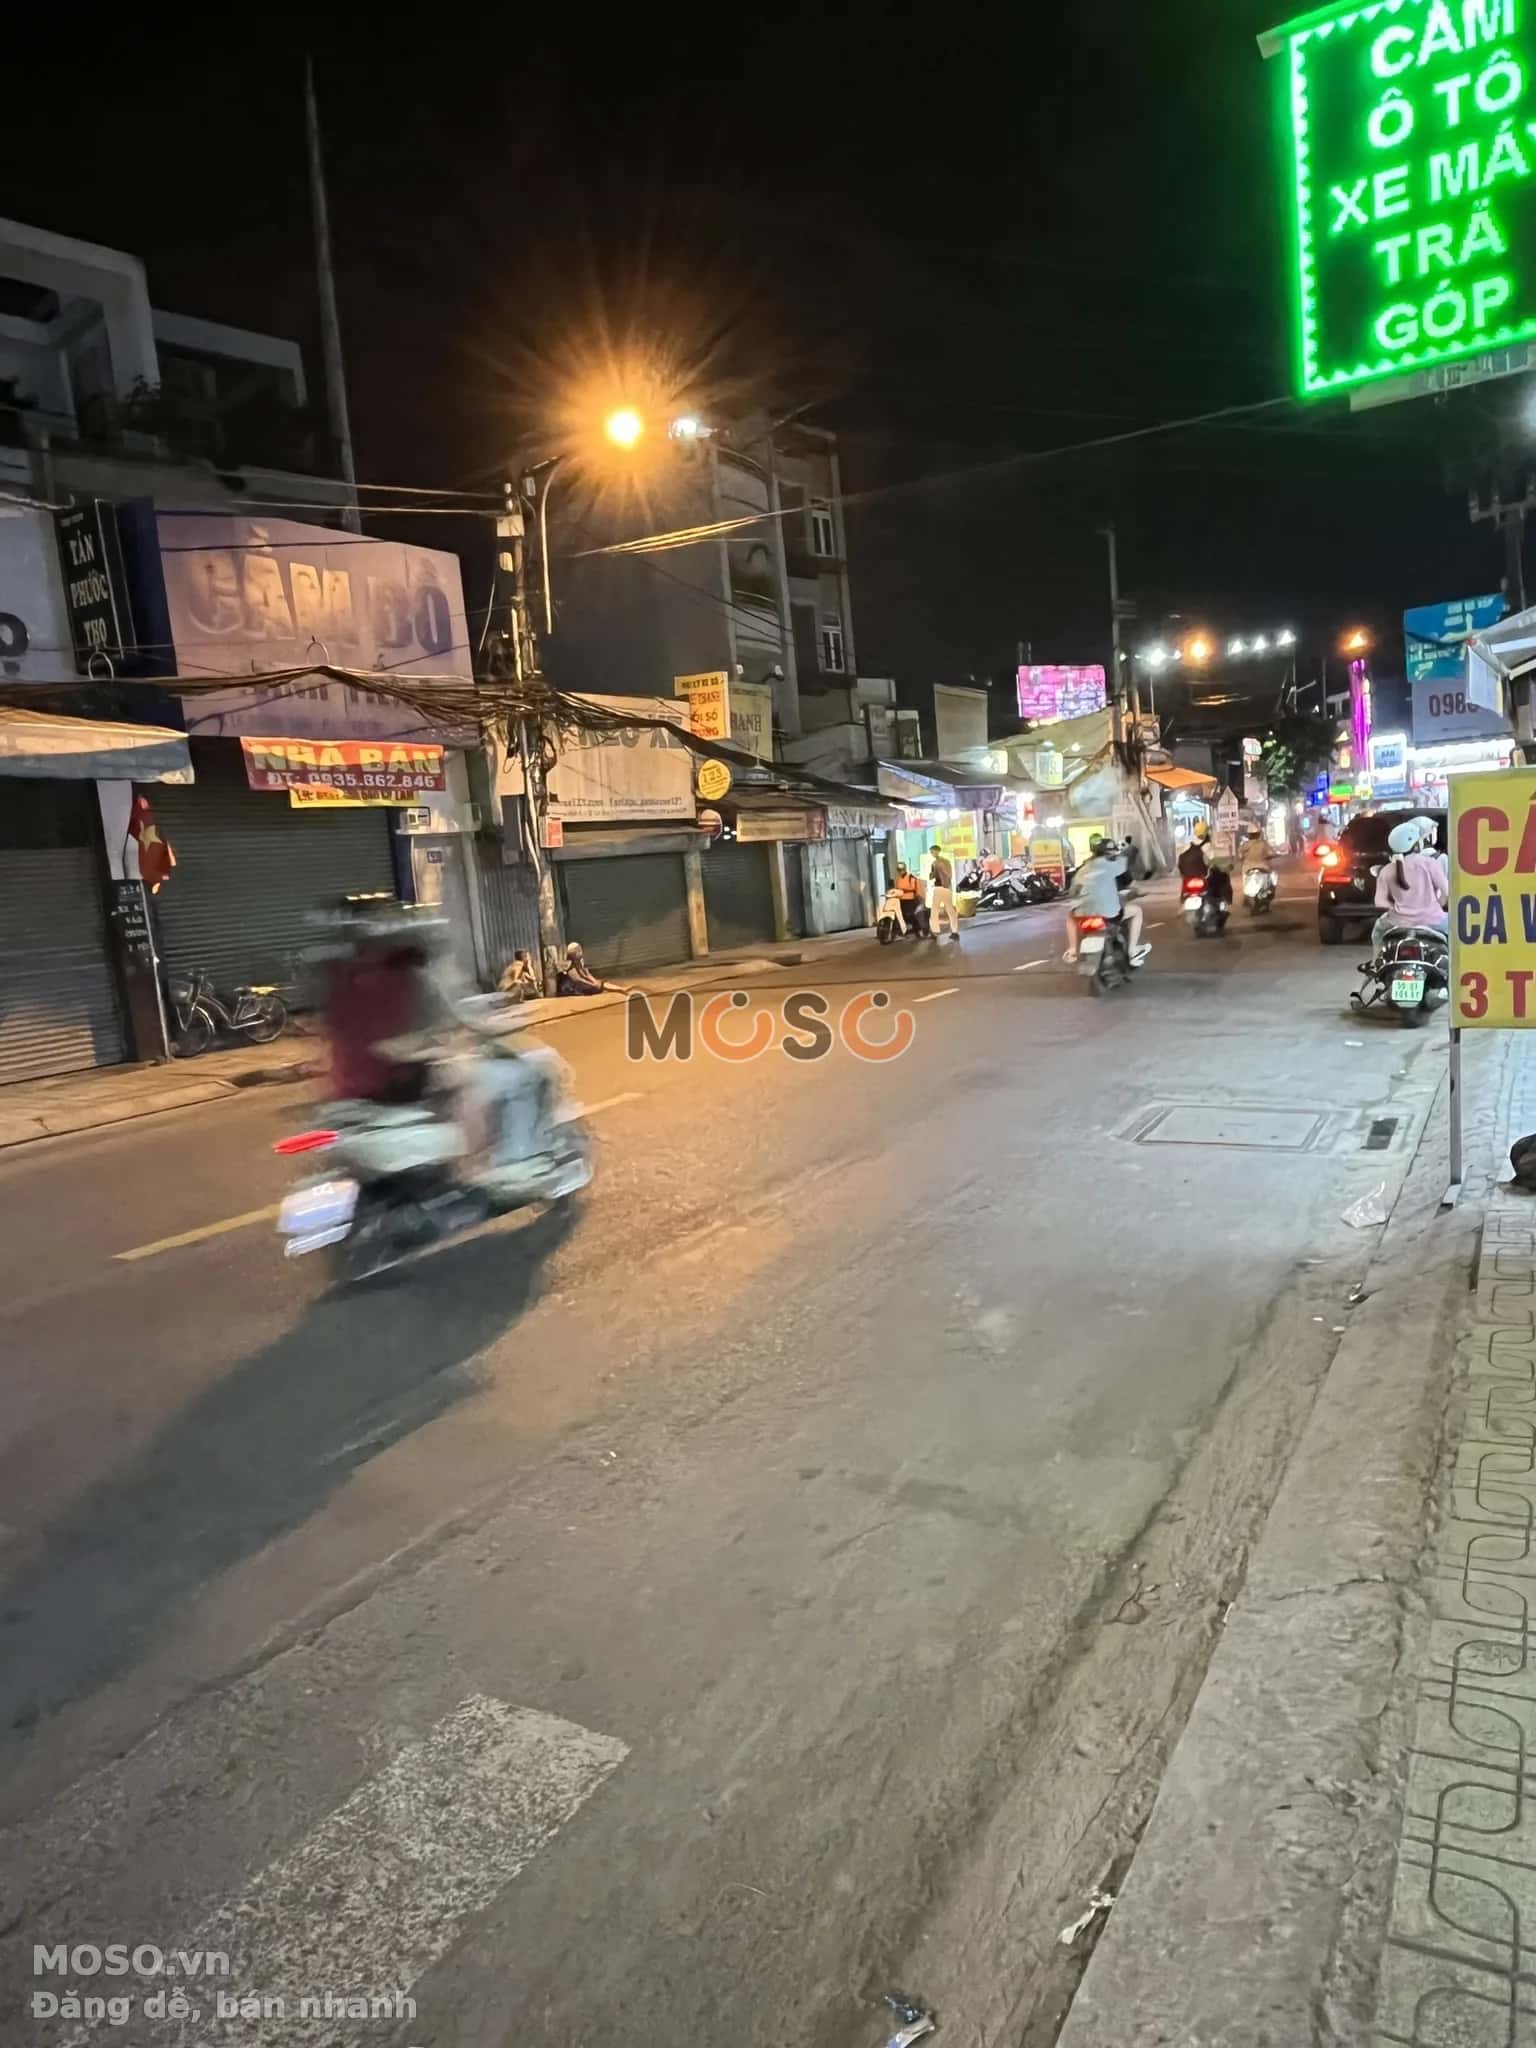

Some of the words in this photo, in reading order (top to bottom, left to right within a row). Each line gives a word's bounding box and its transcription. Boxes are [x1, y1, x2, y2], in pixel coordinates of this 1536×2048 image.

[1368, 87, 1414, 149] Ô
[1434, 48, 1522, 127] TÔ
[1330, 164, 1410, 234] XE
[1430, 118, 1536, 204] MÁ
[1374, 278, 1511, 350] GÓP
[1457, 883, 1508, 945] CÀ
[1459, 971, 1488, 1019] 3
